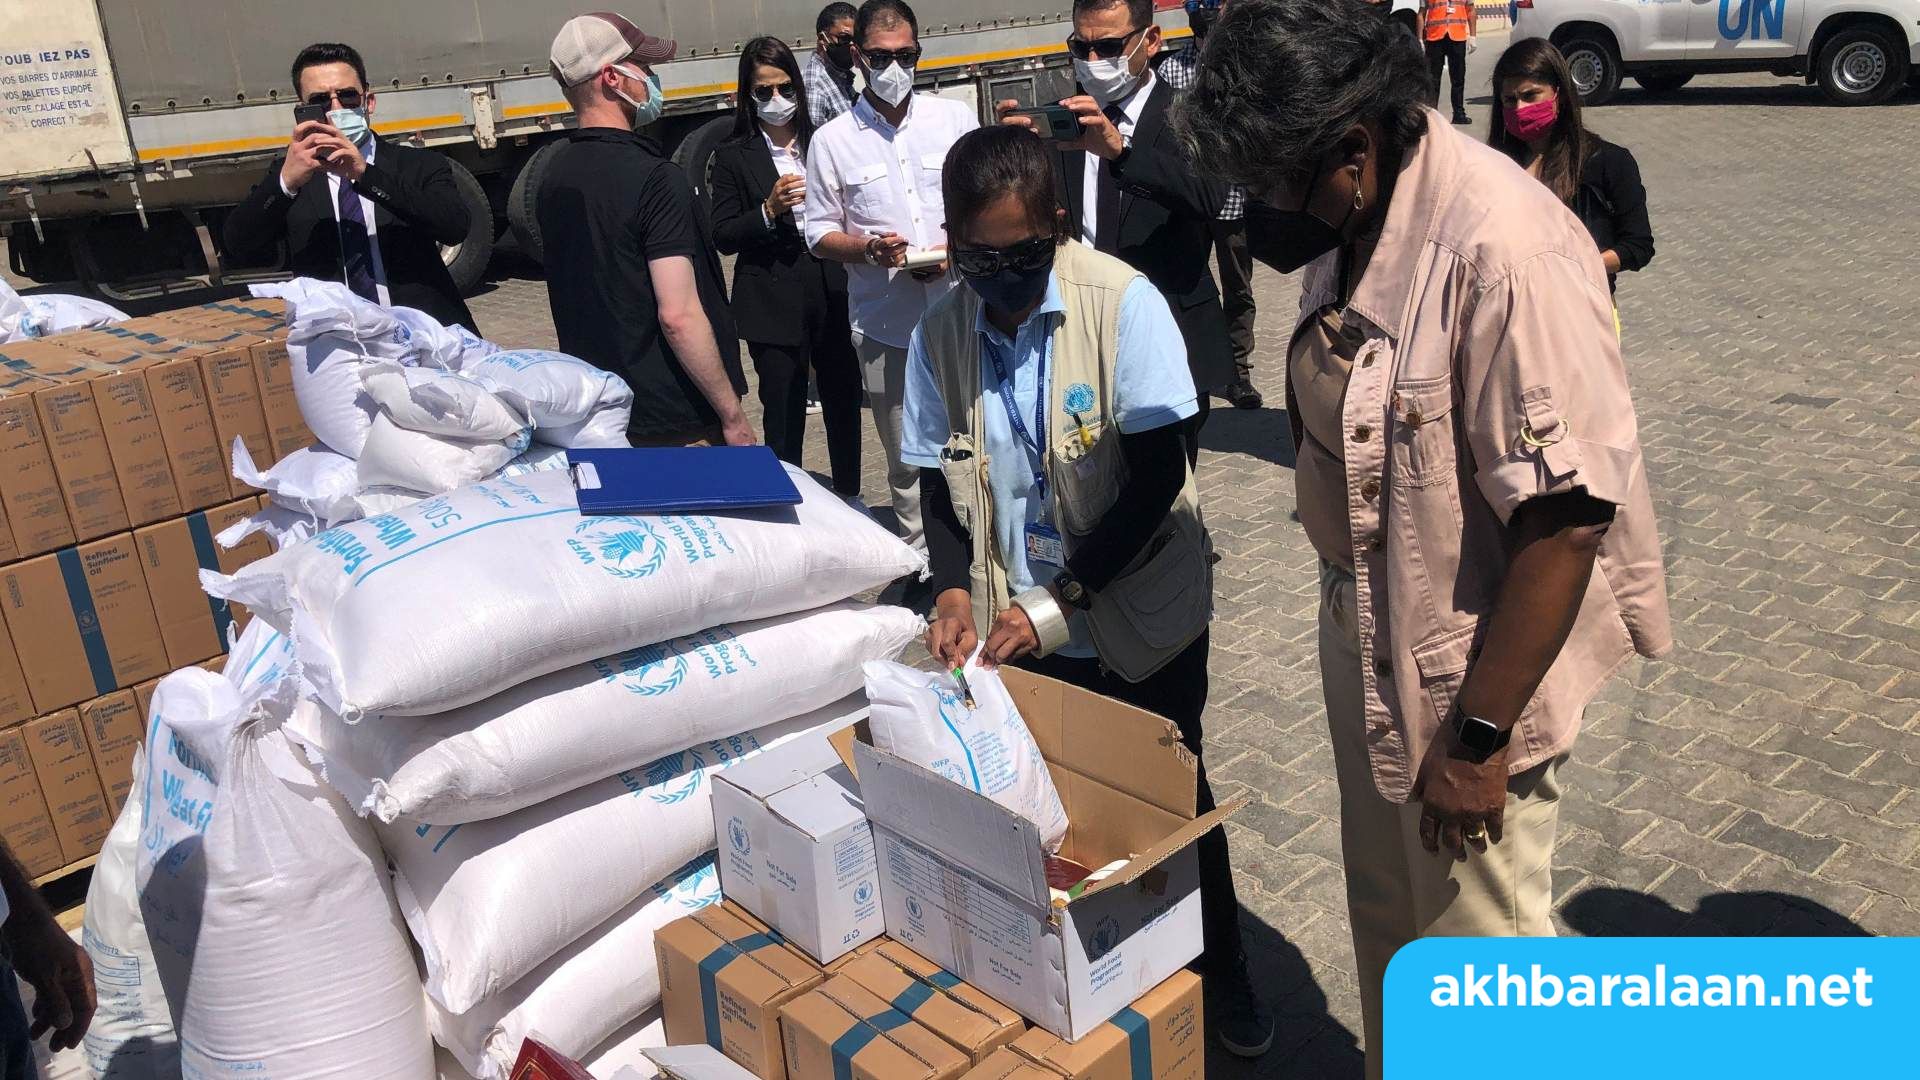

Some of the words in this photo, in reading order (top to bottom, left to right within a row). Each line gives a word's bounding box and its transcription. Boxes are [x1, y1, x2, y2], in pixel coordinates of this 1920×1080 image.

[1718, 0, 1785, 41] UN
[65, 48, 90, 60] PAS
[18, 72, 50, 84] BARRES
[52, 68, 98, 81] D'ARRIMAGE
[3, 91, 20, 101] VOS
[21, 87, 61, 99] PALETTES
[62, 83, 93, 95] EUROPE
[6, 104, 33, 116] VOTRE
[35, 101, 66, 112] CALAGE
[31, 116, 66, 128] CORRECT
[566, 538, 596, 565] WFP
[669, 524, 700, 564] World
[84, 547, 118, 562] Refined
[87, 552, 129, 569] Sunflower
[89, 567, 102, 576] Oil
[687, 640, 722, 679] World
[1089, 960, 1108, 978] World
[1107, 951, 1122, 967] Food
[1090, 961, 1122, 985] Programme
